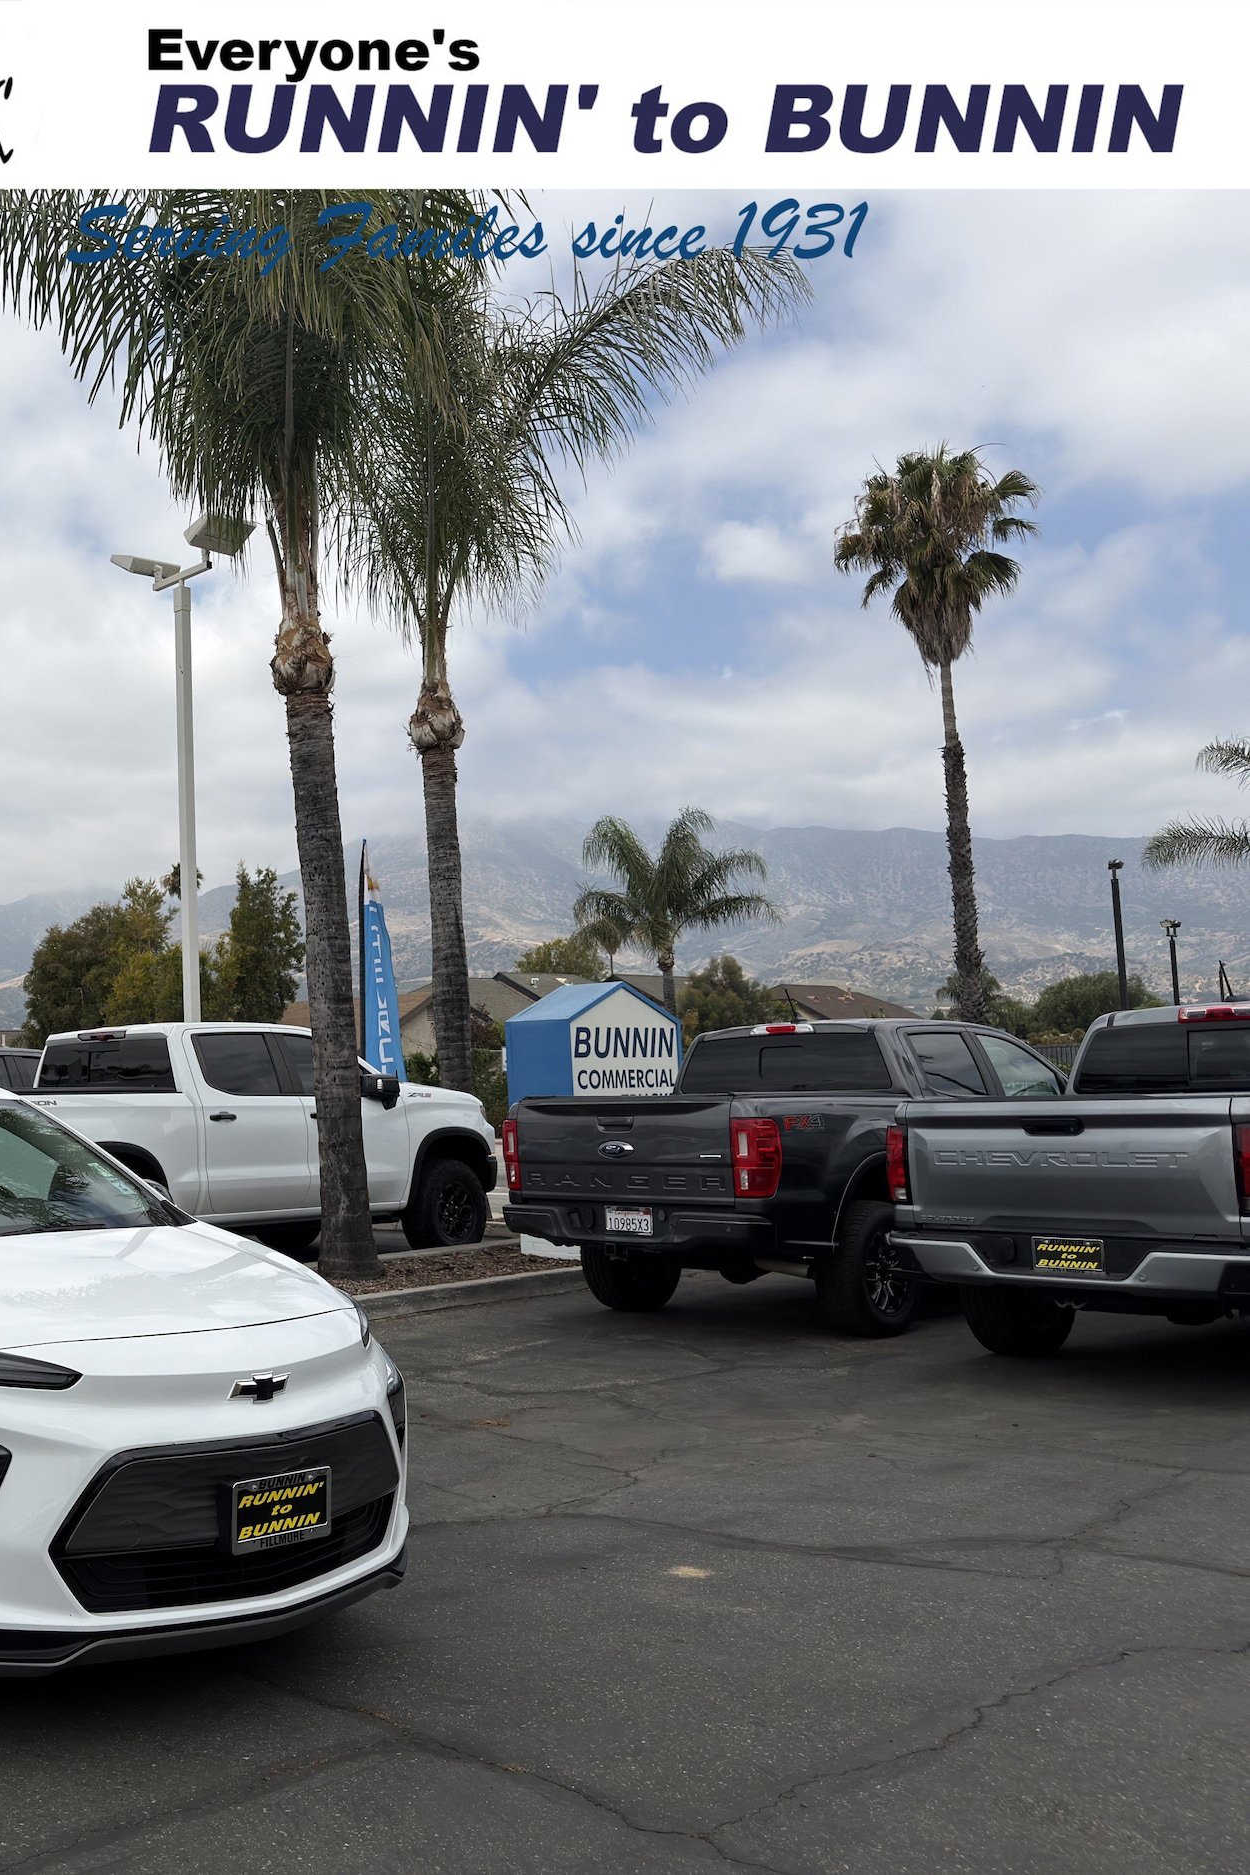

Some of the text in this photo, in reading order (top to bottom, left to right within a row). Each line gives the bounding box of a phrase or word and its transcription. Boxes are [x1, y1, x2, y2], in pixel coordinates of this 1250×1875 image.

[574, 1026, 674, 1059] BUNNIN
[577, 1069, 675, 1090] COMMERCIAL
[782, 1113, 824, 1132] FX4
[934, 1150, 1189, 1168] CHEVROLET
[526, 1173, 726, 1191] RANGER
[609, 1217, 650, 1232] 10985X3
[1037, 1243, 1100, 1254] RUNNIN'
[1038, 1259, 1098, 1269] BUNNIN
[238, 1481, 325, 1509] RUNNIN'
[271, 1504, 293, 1516] to
[238, 1512, 321, 1541] BUNNIN
